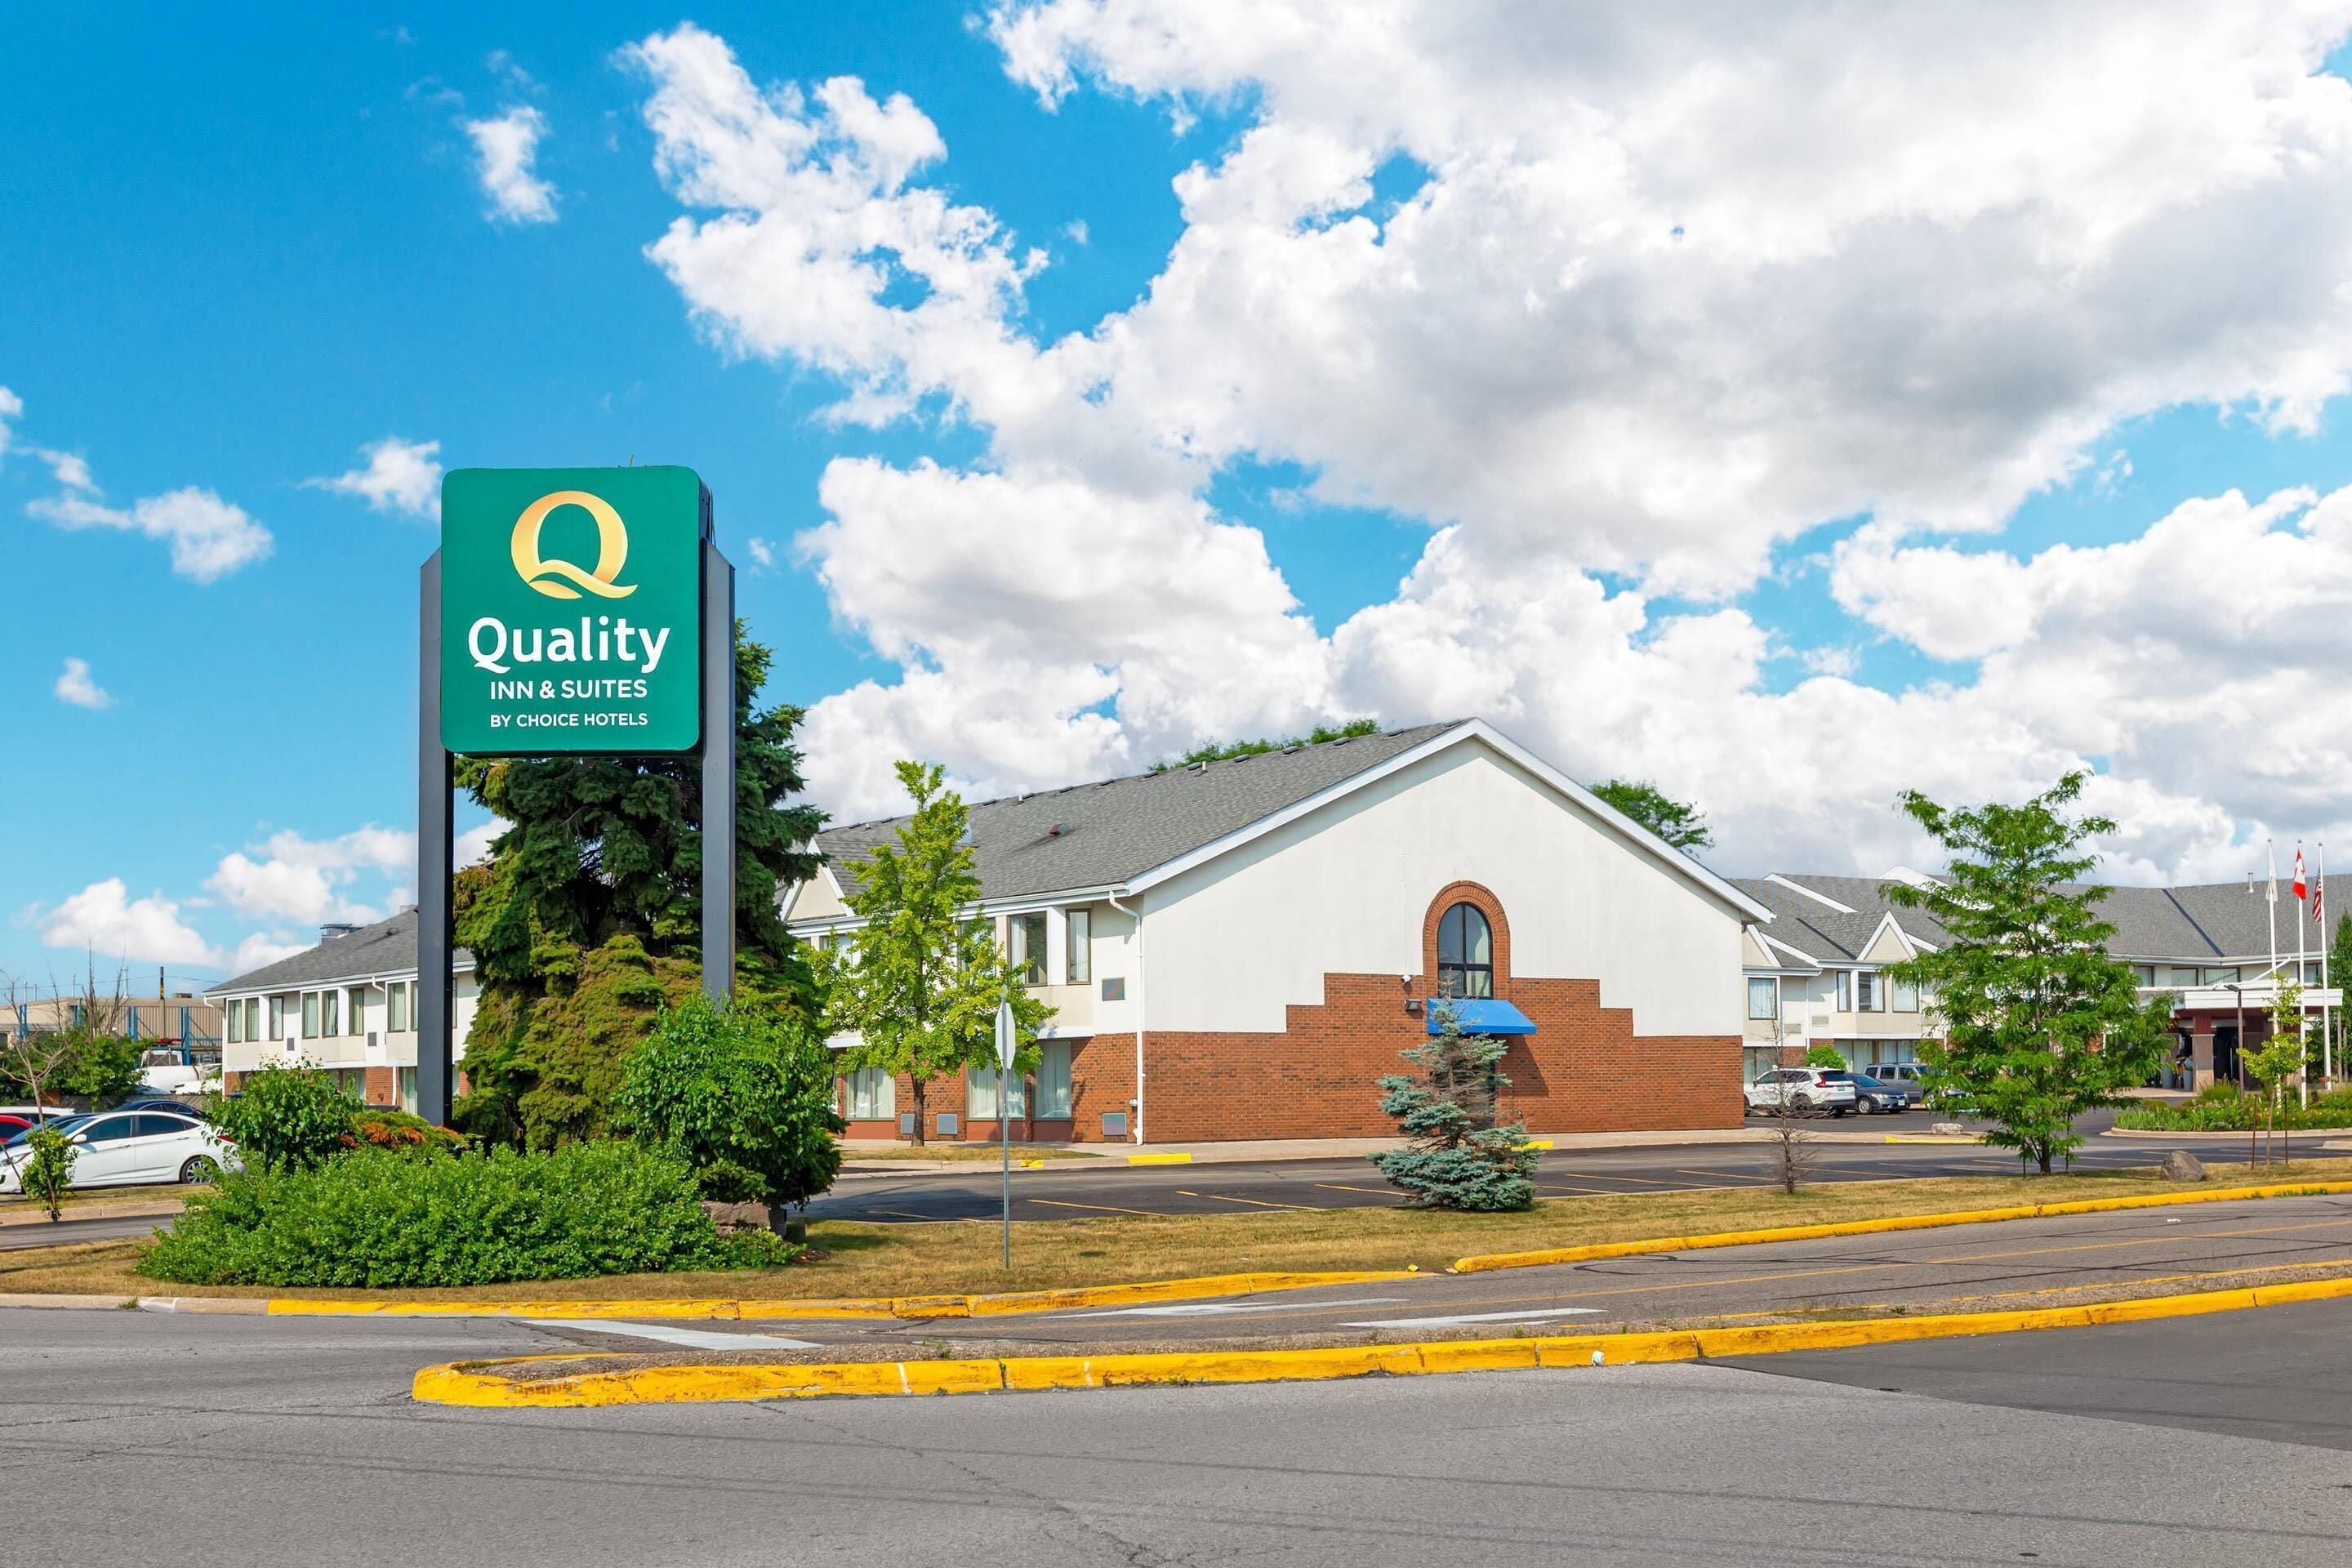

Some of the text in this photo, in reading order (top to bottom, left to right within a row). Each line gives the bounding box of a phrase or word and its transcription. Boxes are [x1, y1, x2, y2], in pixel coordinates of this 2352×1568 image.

[510, 490, 639, 599] Q
[468, 615, 670, 674] Quality
[490, 679, 648, 700] INN & SUITES
[490, 712, 648, 728] BY CHOICE HOTELS
